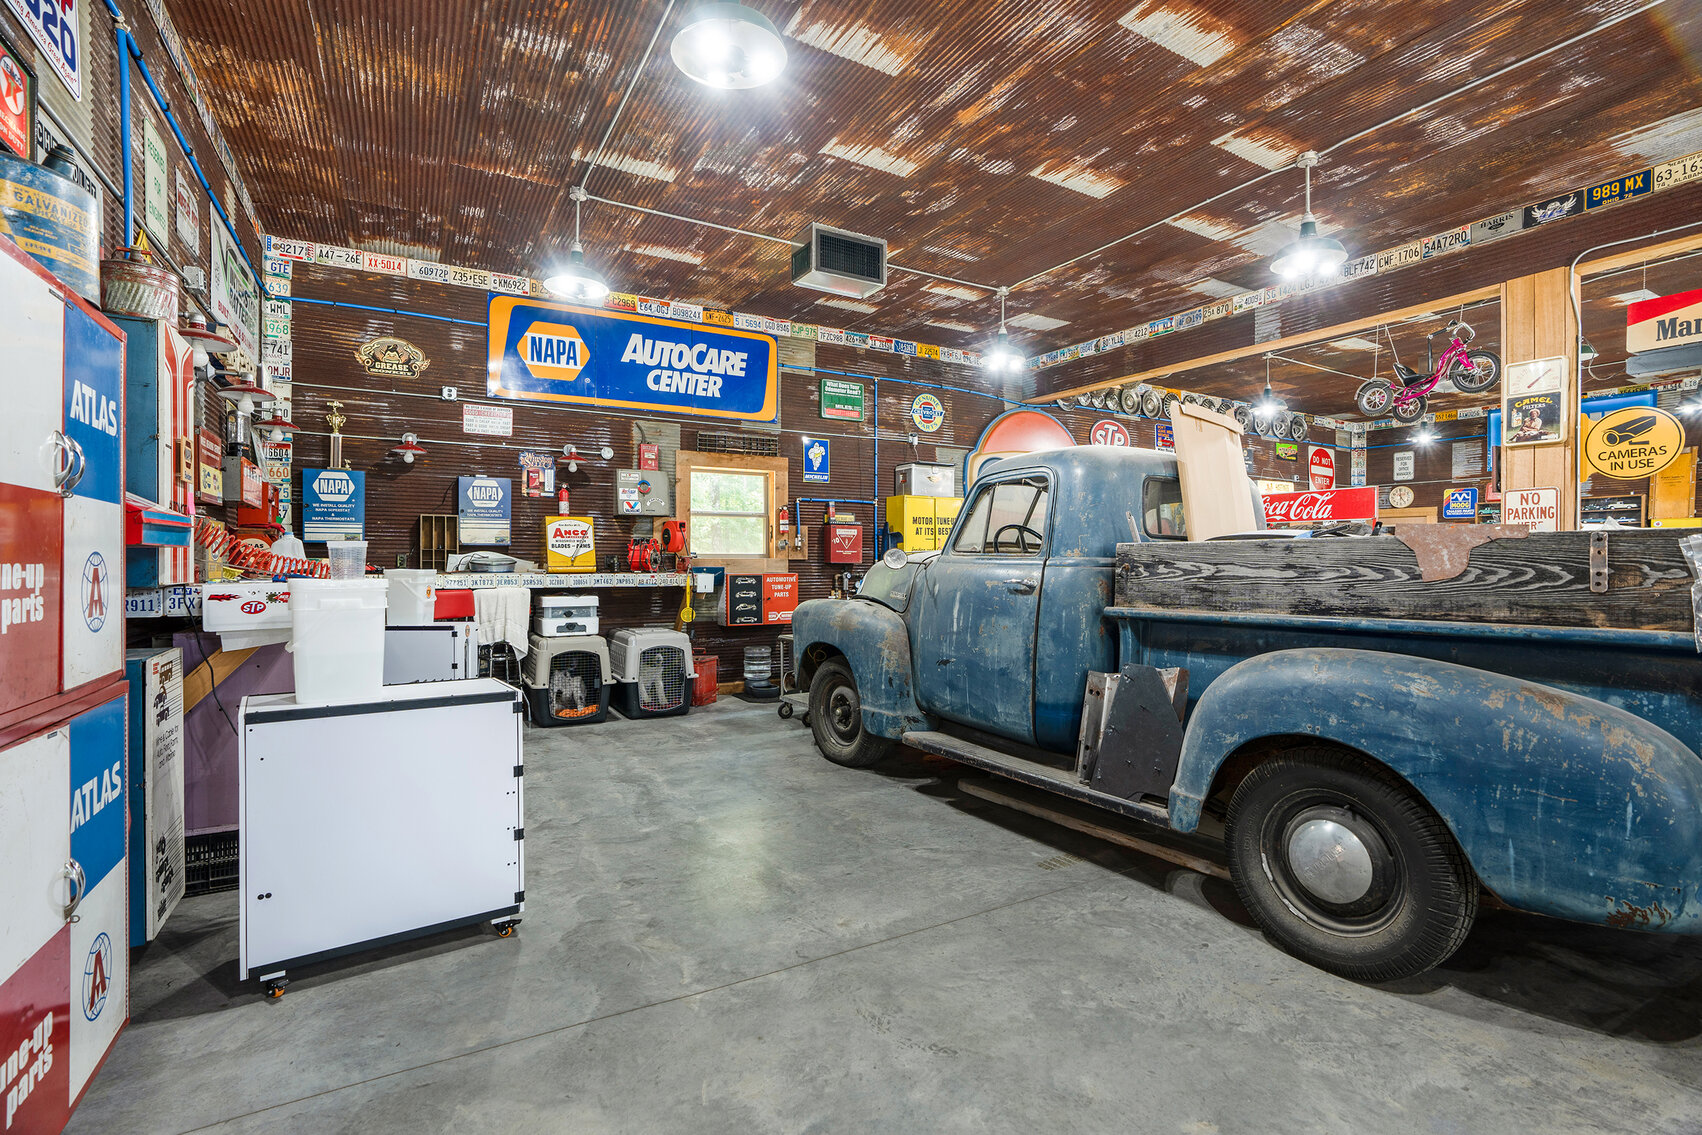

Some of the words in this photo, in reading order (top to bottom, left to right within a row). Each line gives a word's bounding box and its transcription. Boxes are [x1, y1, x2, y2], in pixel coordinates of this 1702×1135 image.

[1593, 183, 1620, 200] 989
[1625, 174, 1644, 191] MX
[1602, 197, 1620, 206] OHIO
[14, 190, 91, 228] GALVANIZED
[1480, 213, 1514, 229] HARRIS
[280, 242, 305, 256] 9217
[270, 262, 290, 274] GTE
[270, 303, 289, 318] WML
[805, 326, 817, 337] 975
[1134, 327, 1148, 338] 4212
[529, 335, 579, 367] NAPA
[375, 362, 409, 371] GREASE
[646, 369, 723, 398] CENTER
[70, 379, 117, 438] ATLAS
[915, 395, 940, 408] GENUINE
[1515, 396, 1553, 408] CAMEL
[918, 420, 938, 430] PARTS
[1095, 423, 1125, 447] STP
[1598, 445, 1667, 461] CAMERAS
[1322, 457, 1331, 465] NOT
[1611, 461, 1624, 471] IN
[1627, 458, 1655, 469] USE
[320, 479, 348, 494] NAPA
[1315, 476, 1330, 485] ENTER
[473, 487, 498, 501] NAPA
[1520, 493, 1540, 505] NO
[1507, 506, 1555, 520] PARKING
[912, 516, 933, 525] MOTOR
[553, 527, 588, 538] ANCO
[915, 527, 922, 535] AT
[924, 527, 934, 535] ITS
[938, 527, 952, 535] BEST
[1, 594, 44, 634] parts
[243, 600, 264, 614] STP
[71, 760, 122, 835] ATLAS
[6, 1043, 53, 1130] parts
